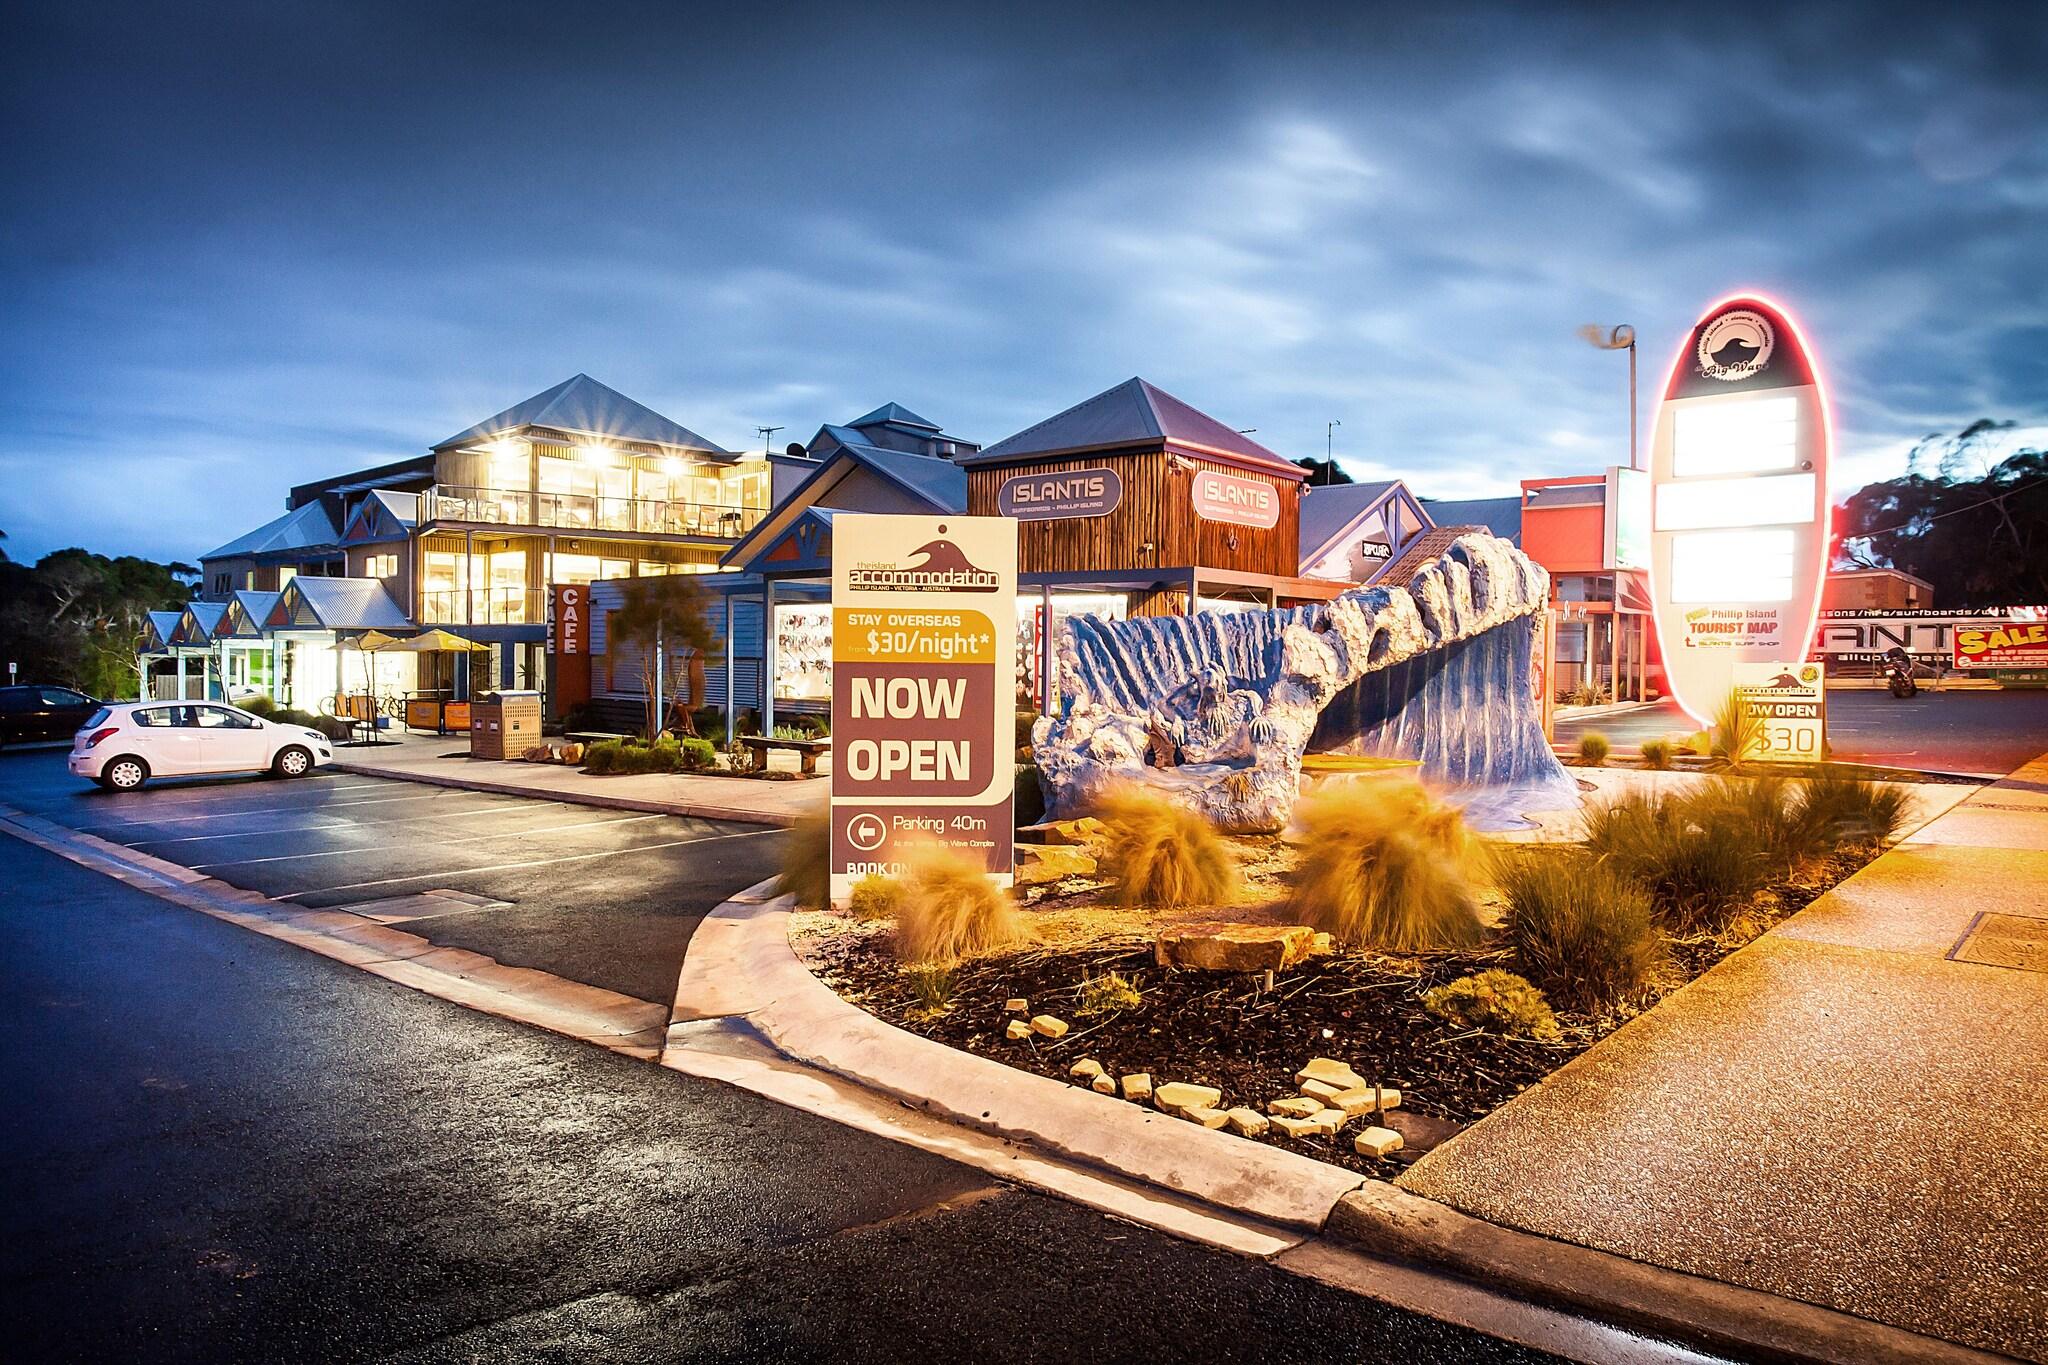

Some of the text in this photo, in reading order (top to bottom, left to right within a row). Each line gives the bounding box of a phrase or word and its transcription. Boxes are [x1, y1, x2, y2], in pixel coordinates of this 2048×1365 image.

[1702, 363, 1730, 378] Big
[1012, 476, 1105, 504] ISLANTIS
[1203, 479, 1270, 510] ISLANTIS
[850, 568, 999, 586] accommodation
[563, 589, 578, 654] CAFE
[848, 613, 961, 627] STAY OVERSEAS
[1711, 610, 1743, 620] Phillip
[1746, 609, 1777, 618] Island
[1690, 622, 1778, 634] TOURIST MAP
[1818, 624, 1953, 647] ANT
[1958, 625, 2048, 654] SALE
[851, 677, 967, 719] NOW
[1775, 704, 1817, 717] OPEN
[1754, 723, 1814, 754] $30
[847, 739, 970, 782] OPEN
[893, 815, 986, 834] Parking 40m
[950, 840, 969, 848] Wave
[846, 862, 888, 875] BOOK
